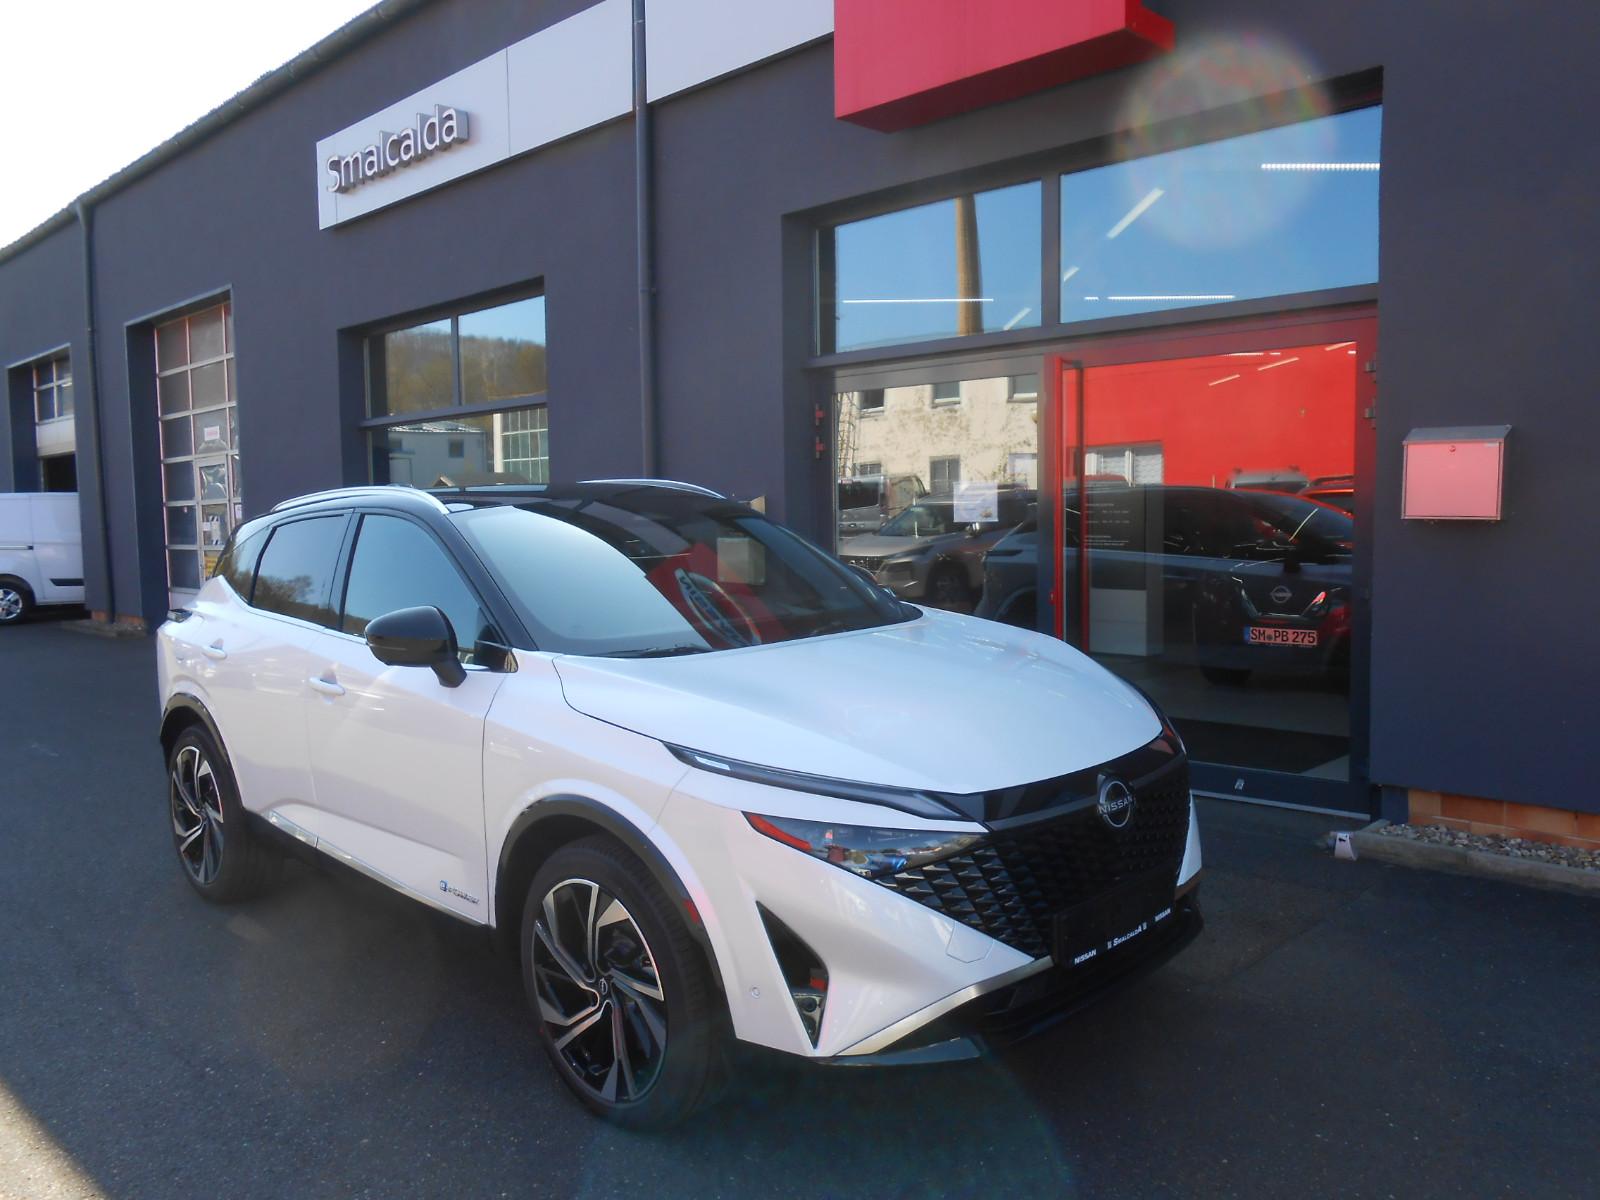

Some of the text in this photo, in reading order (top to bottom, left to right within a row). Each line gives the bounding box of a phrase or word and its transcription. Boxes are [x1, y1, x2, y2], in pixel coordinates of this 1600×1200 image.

[327, 104, 462, 193] Smalcalda
[1251, 628, 1316, 644] SM PB 275
[1097, 795, 1133, 815] NISSAN
[1074, 949, 1097, 965] NISSAN
